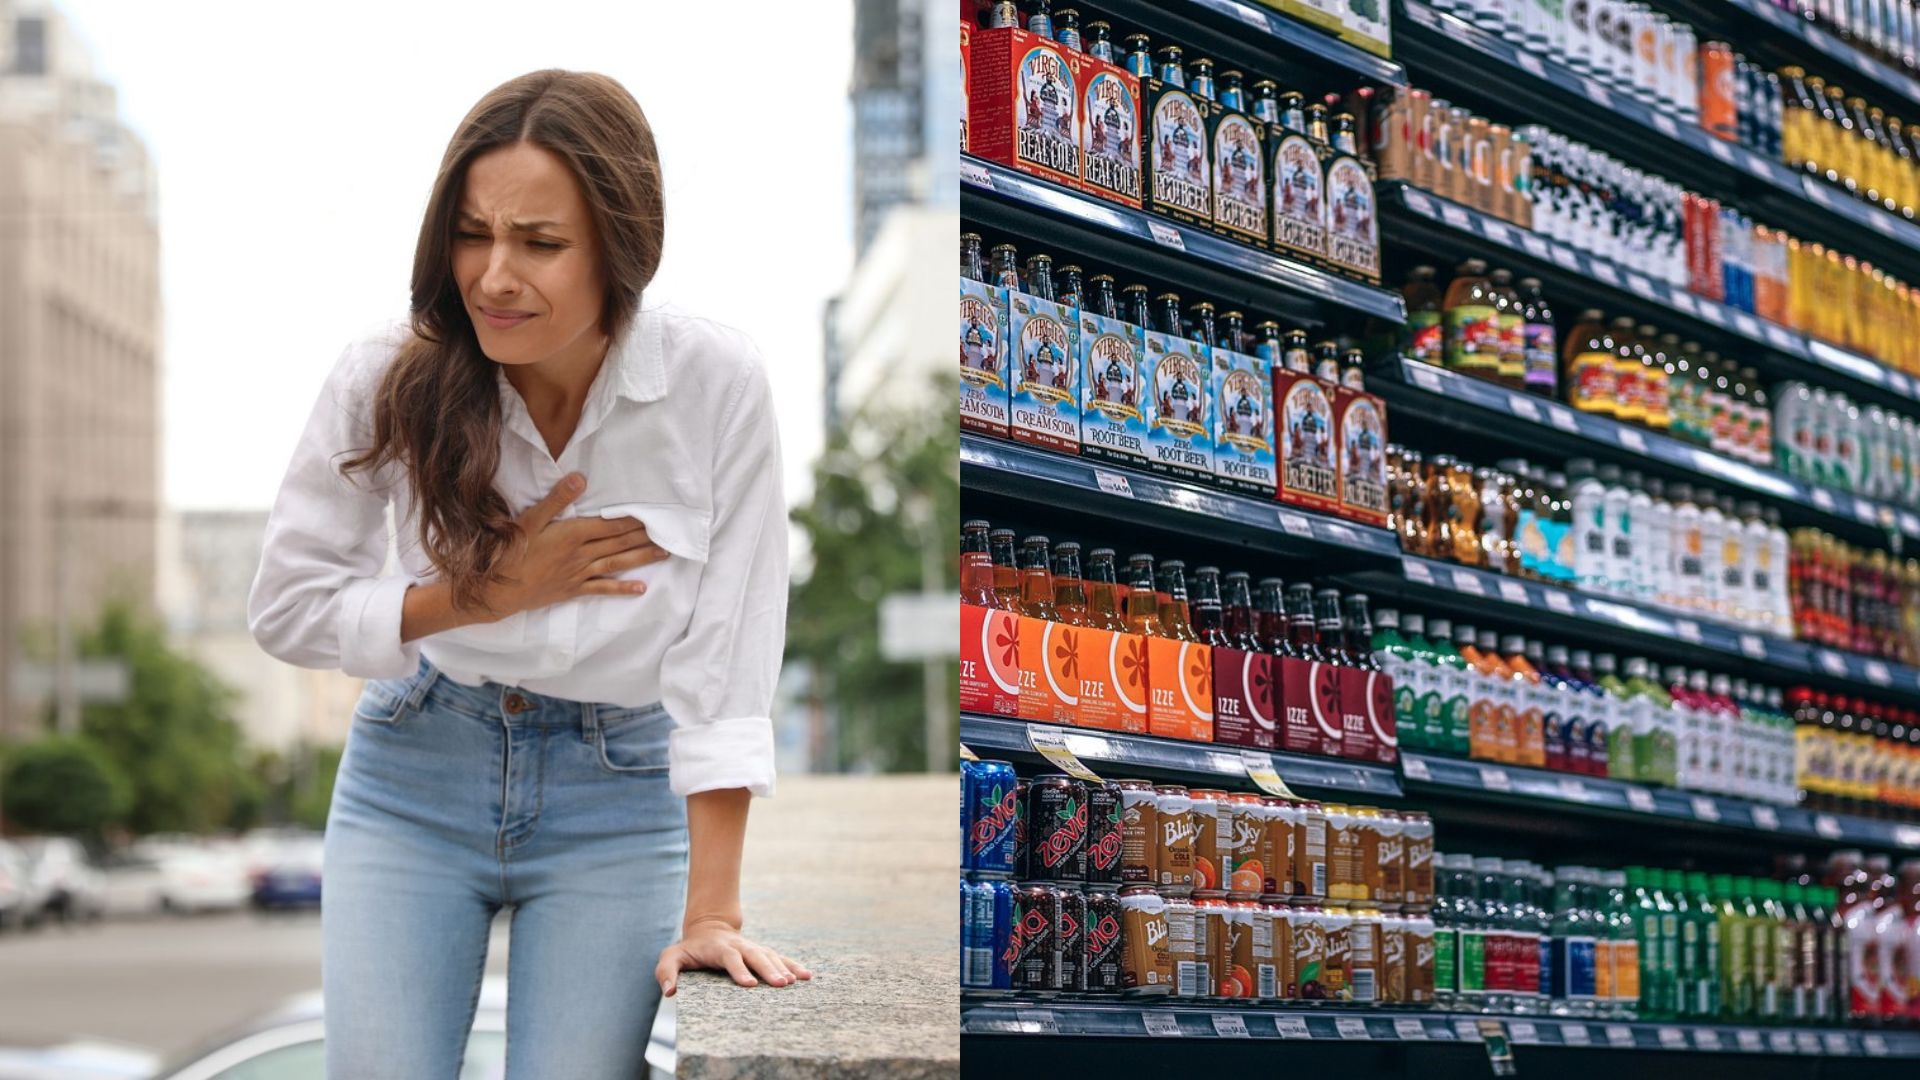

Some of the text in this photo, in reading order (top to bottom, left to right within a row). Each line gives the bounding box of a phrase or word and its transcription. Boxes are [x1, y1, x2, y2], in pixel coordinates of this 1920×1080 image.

[1018, 127, 1080, 176] REAL COLA
[1084, 152, 1140, 198] REAL COLA
[966, 388, 986, 400] ZERO
[960, 398, 1004, 420] EAM SODA
[1038, 404, 1057, 417] ZERO
[1016, 409, 1052, 430] CREAM
[1052, 418, 1076, 436] SODA
[1108, 421, 1126, 433] ZERO
[1090, 428, 1119, 445] ROOT
[1118, 433, 1143, 453] BEER
[1173, 438, 1192, 450] ZERO
[1155, 445, 1208, 470] ROOT BEER
[1223, 460, 1272, 484] ROOT BEER
[960, 660, 976, 678] ZE
[1018, 669, 1036, 688] ZZE
[1080, 679, 1104, 698] IZZE
[1152, 687, 1174, 707] IZZE
[1218, 697, 1239, 715] IZZE
[1286, 706, 1308, 725] IZZE
[1343, 714, 1365, 732] IZZE
[1232, 819, 1261, 849] Sky
[1087, 820, 1122, 871] zev
